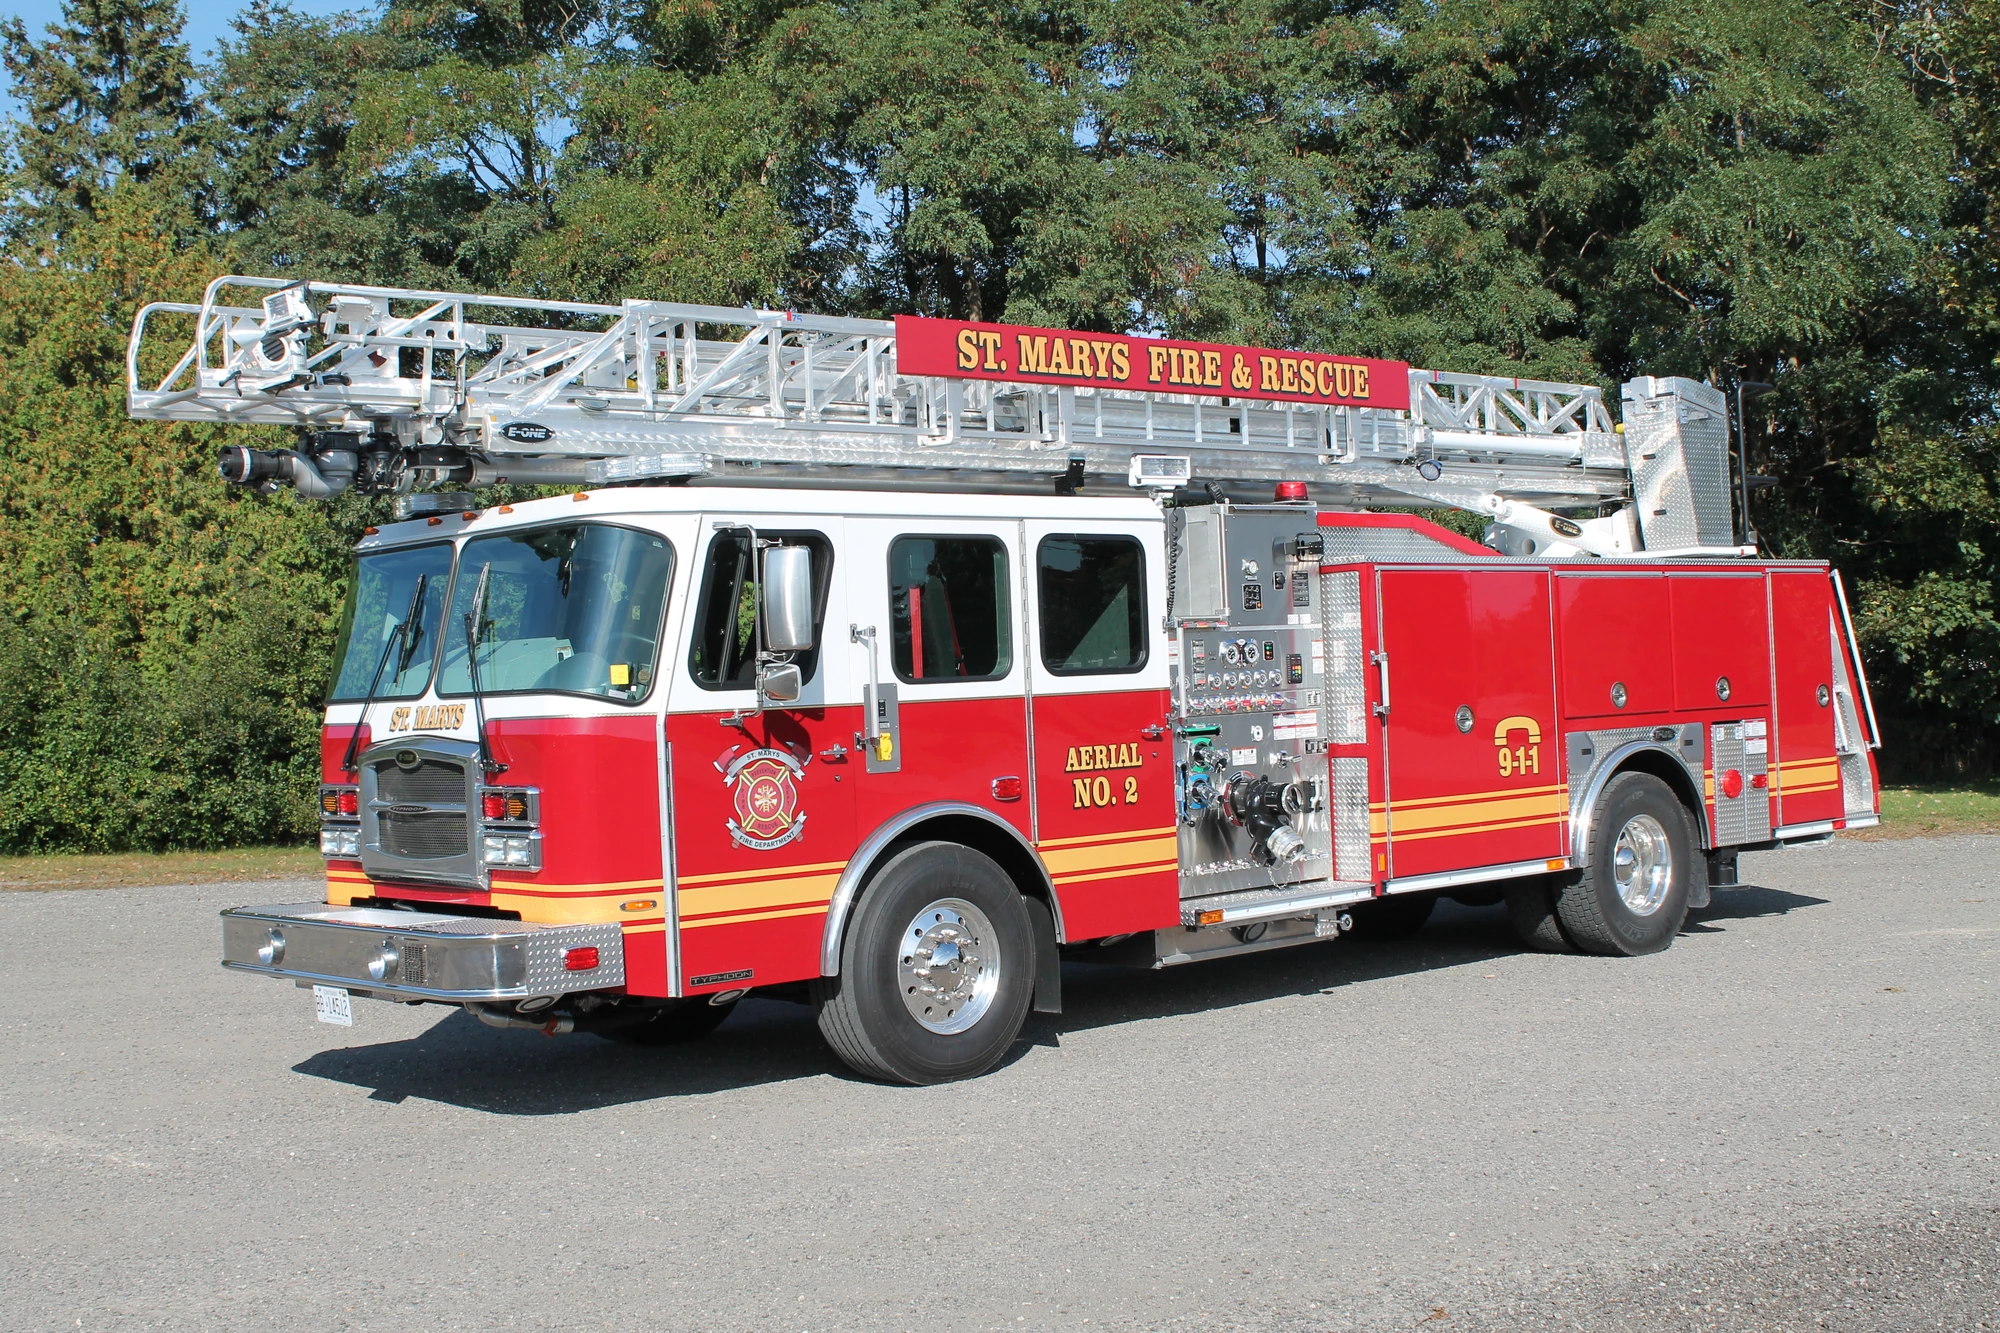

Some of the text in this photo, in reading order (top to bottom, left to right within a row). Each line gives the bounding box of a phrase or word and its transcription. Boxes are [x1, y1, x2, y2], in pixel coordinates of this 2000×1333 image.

[957, 328, 1369, 399] ST. MARYS FIRE & RESCUE
[508, 426, 547, 439] E-ONE
[389, 703, 467, 732] ST. MARYS
[746, 749, 780, 761] ST. MARYS
[1064, 742, 1143, 773] AERIAL
[1498, 745, 1539, 778] 9-1-1
[1072, 776, 1139, 809] NO. 2
[757, 822, 778, 831] RESCUE
[739, 831, 796, 848] FIRE DEPARTMENT
[691, 970, 752, 984] TYPHOON
